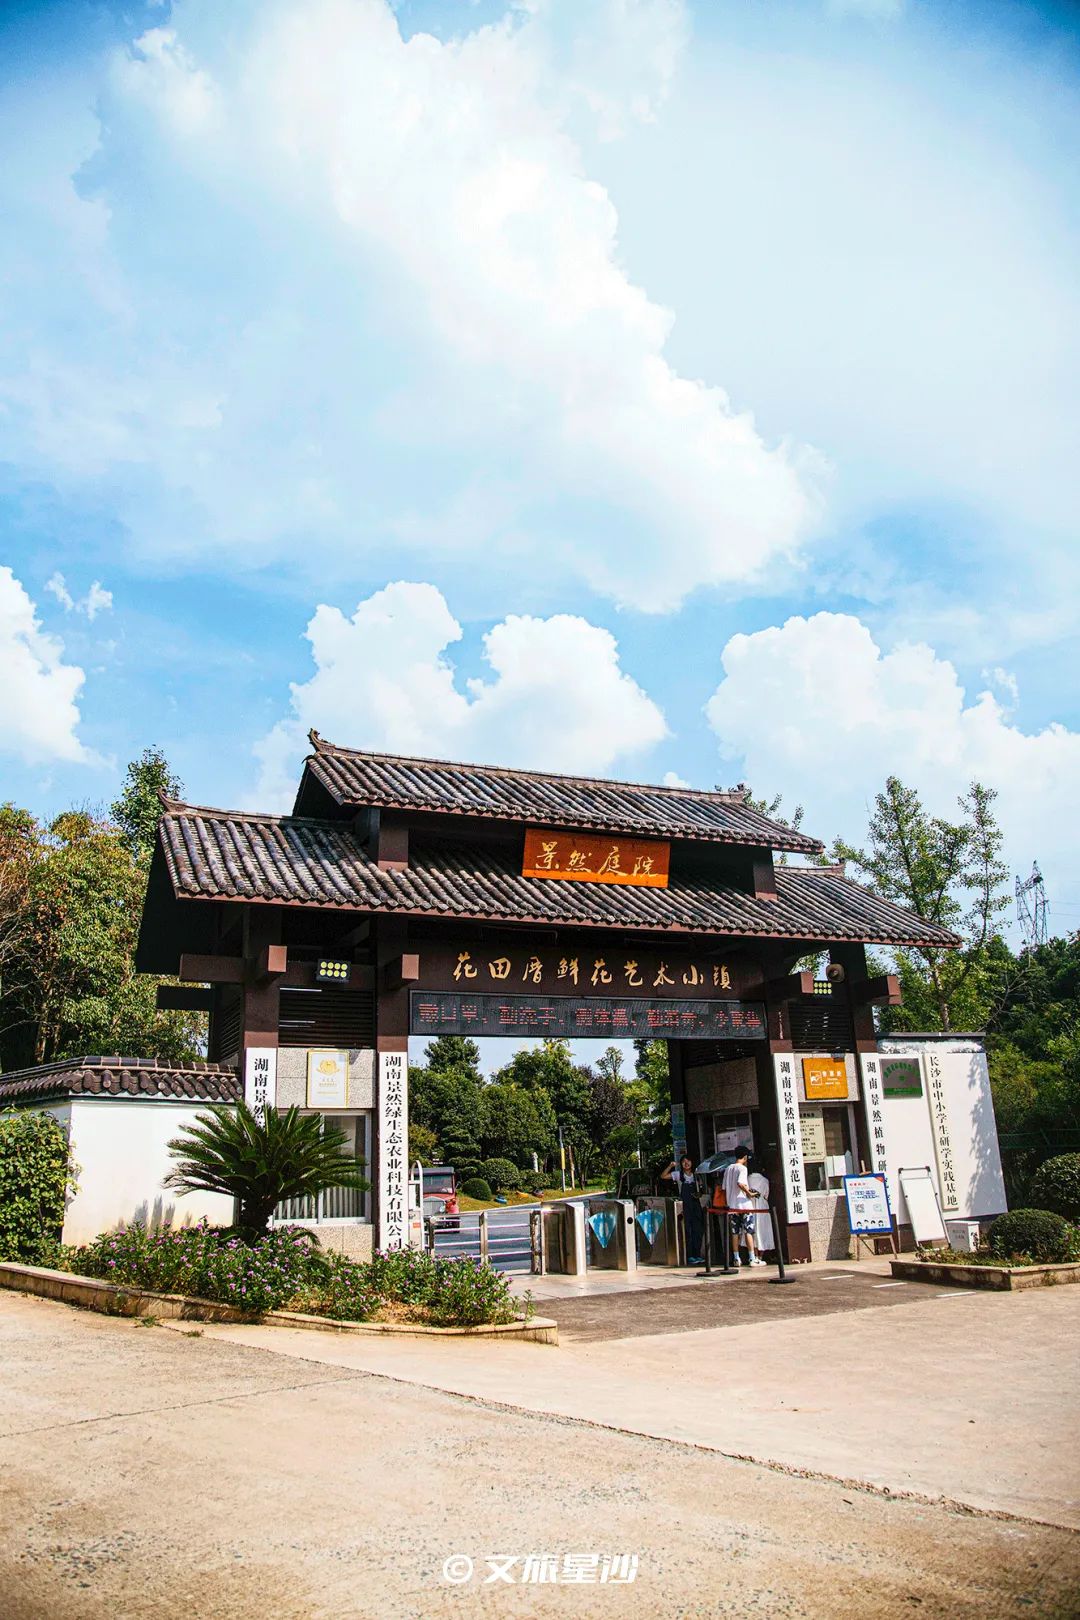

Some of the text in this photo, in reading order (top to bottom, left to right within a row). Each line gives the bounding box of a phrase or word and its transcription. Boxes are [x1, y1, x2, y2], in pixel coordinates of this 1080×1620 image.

[535, 841, 658, 877] 景然庭院
[254, 1058, 269, 1129] 湖南景然
[385, 1056, 403, 1250] 湖南景然绿生态农业科技有限公司
[780, 1061, 804, 1215] 湖南景然科普示范基地
[929, 1056, 959, 1207] 长沙市中小学生研学实践基地
